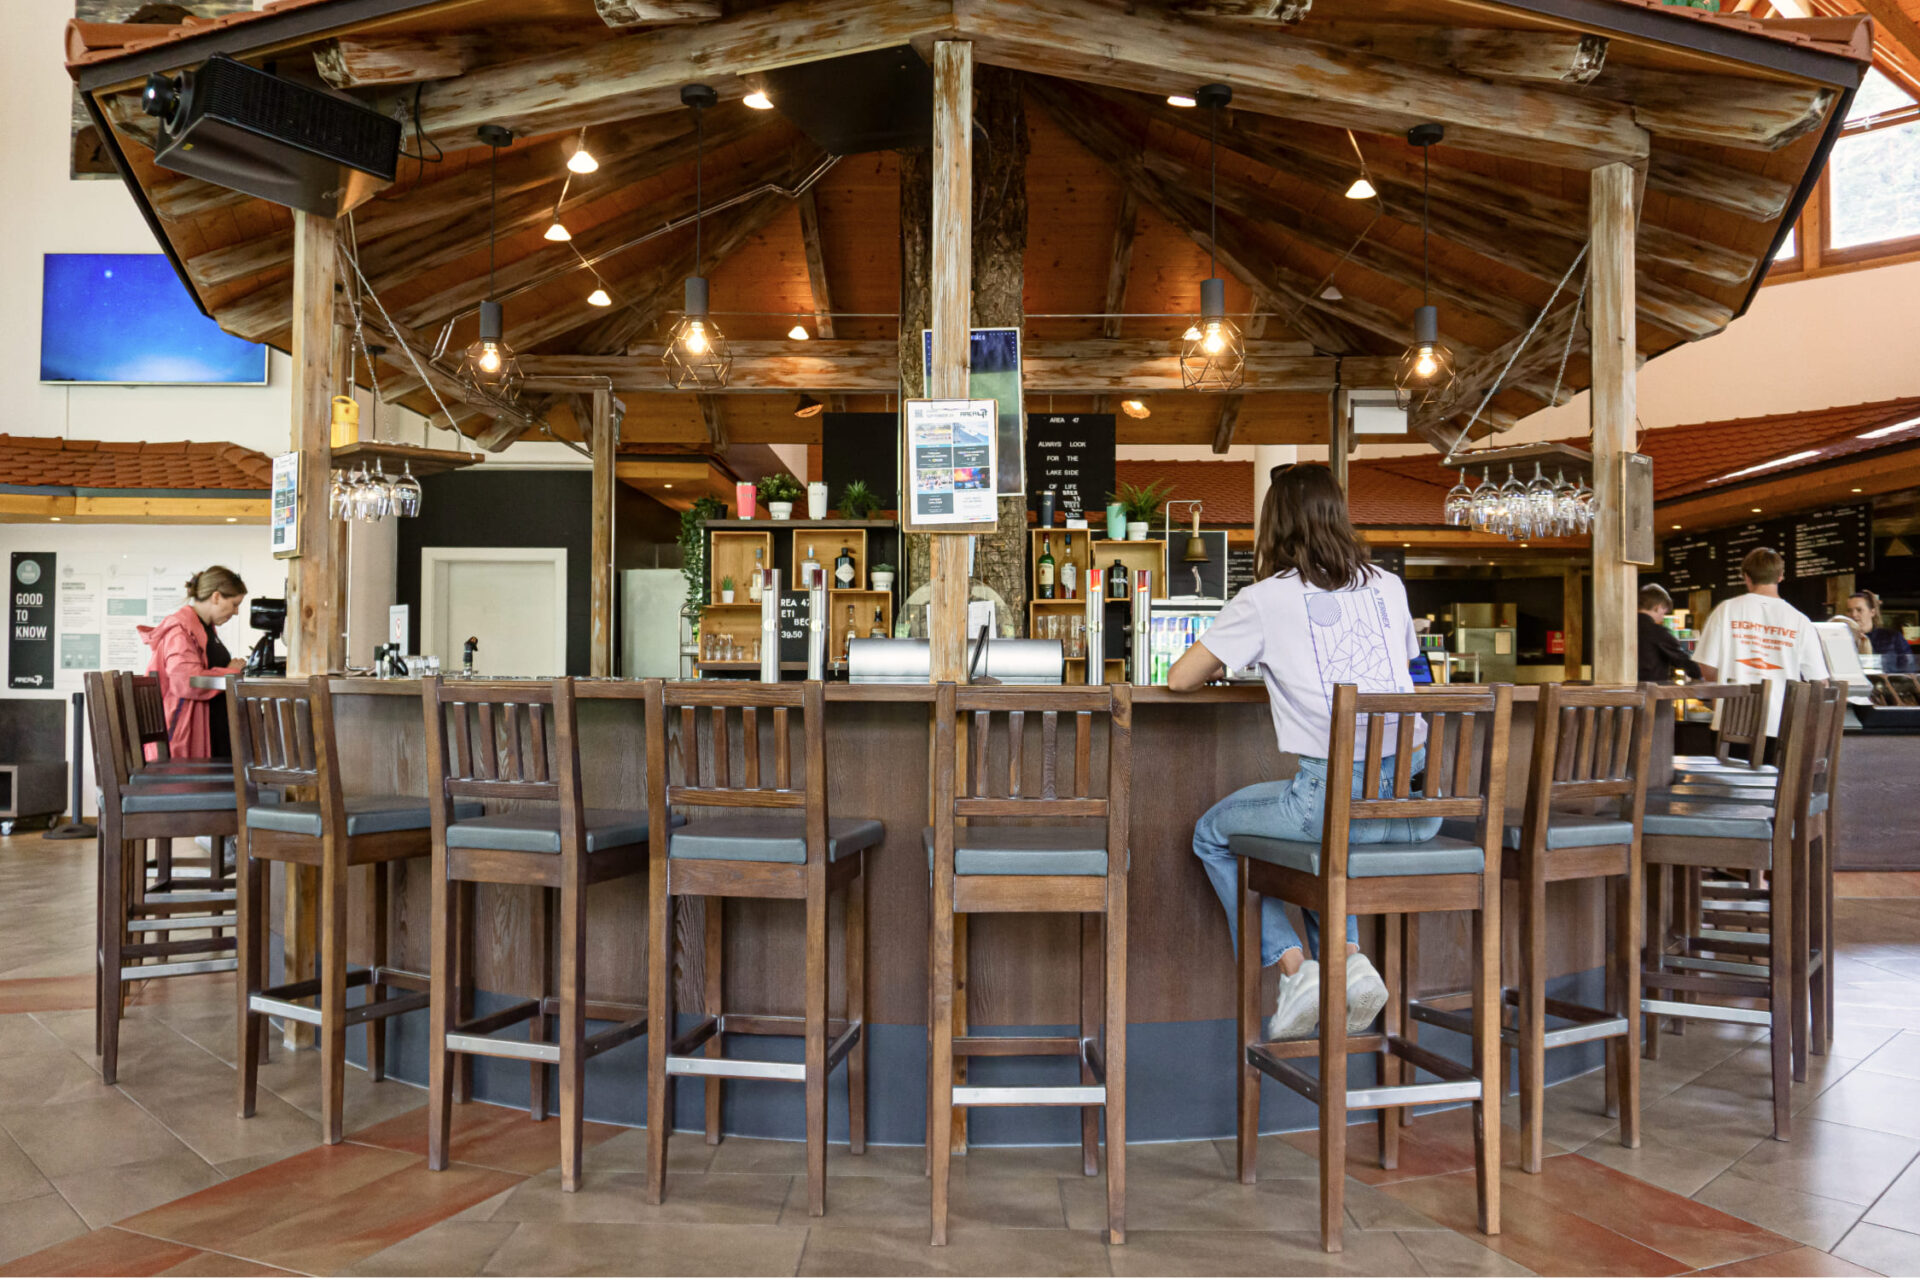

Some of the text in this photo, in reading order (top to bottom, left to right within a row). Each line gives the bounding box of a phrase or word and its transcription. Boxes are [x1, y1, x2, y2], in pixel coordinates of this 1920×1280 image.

[15, 593, 43, 605] GOOD
[780, 598, 798, 607] REA
[15, 609, 28, 621] TO
[781, 609, 795, 618] ETI
[1376, 597, 1391, 628] TERREX
[793, 618, 810, 626] BEC
[15, 626, 47, 638] KNOW
[1730, 620, 1797, 639] EIGHTYFIVE
